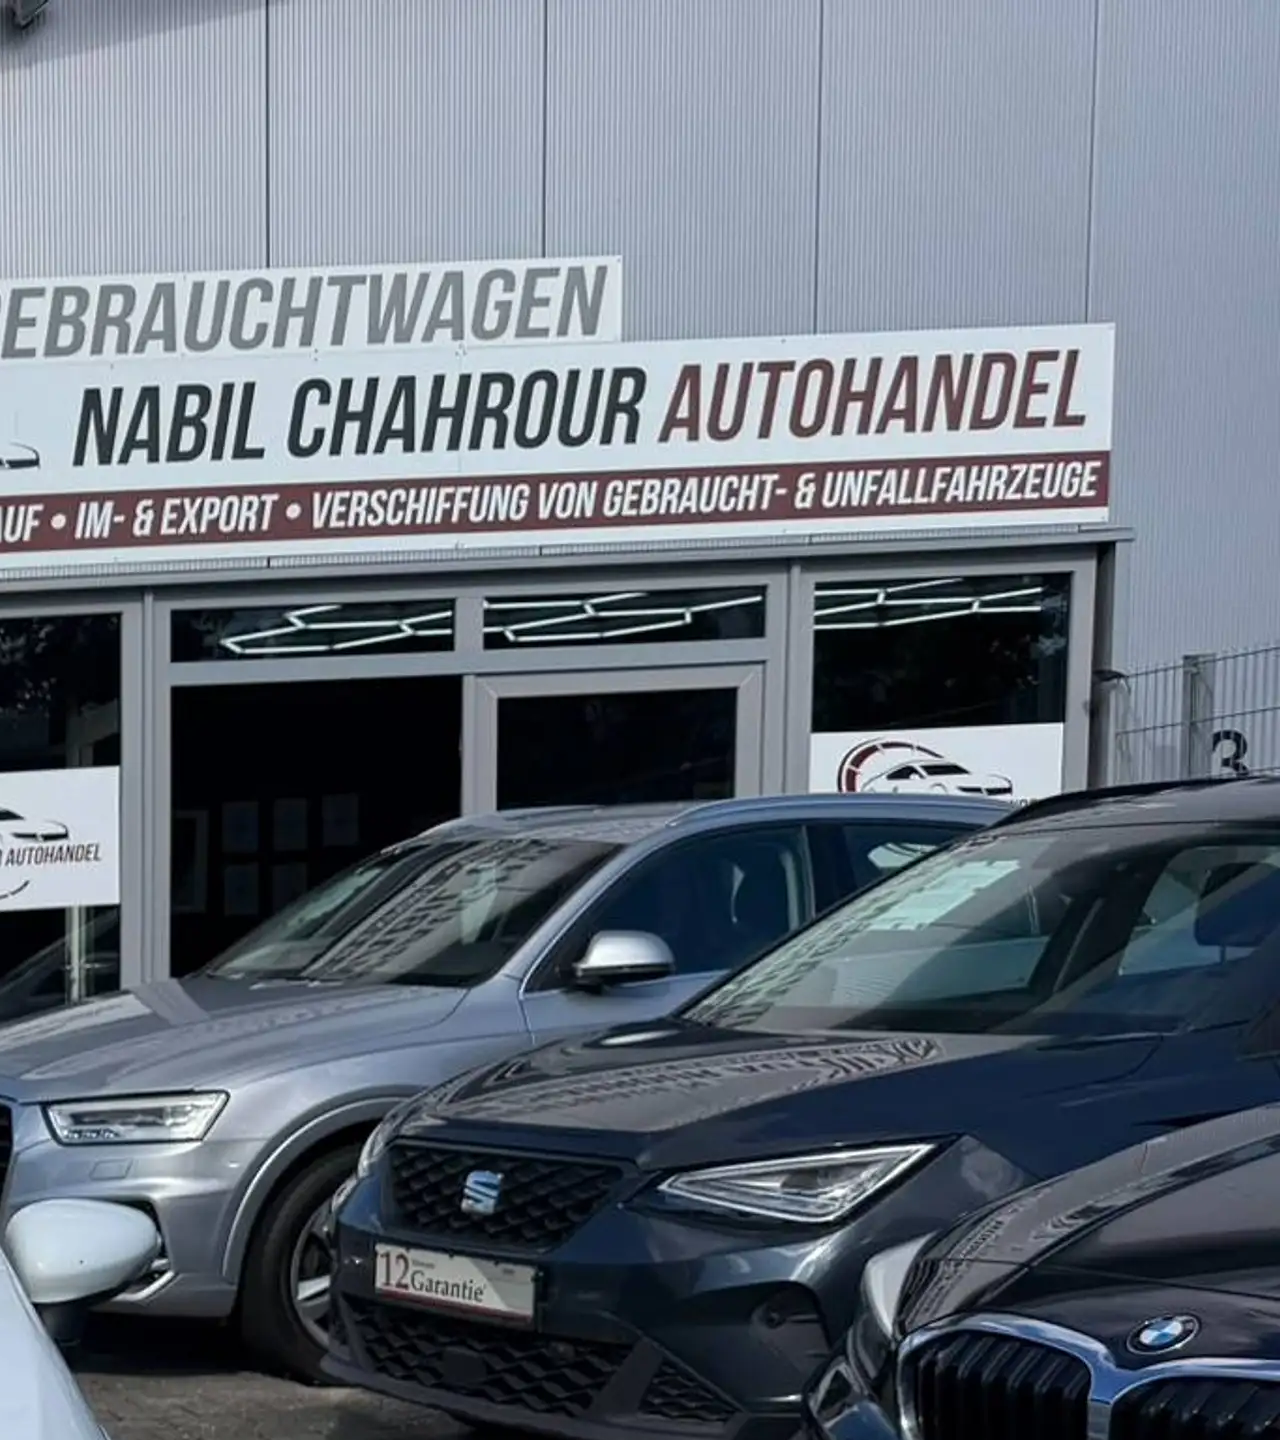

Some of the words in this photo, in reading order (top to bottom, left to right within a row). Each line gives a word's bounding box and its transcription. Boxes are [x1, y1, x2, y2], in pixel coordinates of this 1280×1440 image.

[72, 381, 266, 466] NABIL
[287, 366, 647, 458] CHAHROUR
[659, 349, 1086, 443] AUTOHANDEL
[74, 501, 125, 539] IM-
[133, 499, 155, 537] &
[160, 494, 279, 535] EXPORT
[312, 483, 529, 529] VERSCHIFFUNG
[538, 481, 597, 520] VON
[603, 473, 787, 517] GEBRAUCHT-
[794, 473, 817, 509] &
[821, 460, 1101, 508] UNFALLFAHRZEUGE
[5, 843, 102, 867] AUTOHANDEL
[380, 1252, 409, 1289] 12
